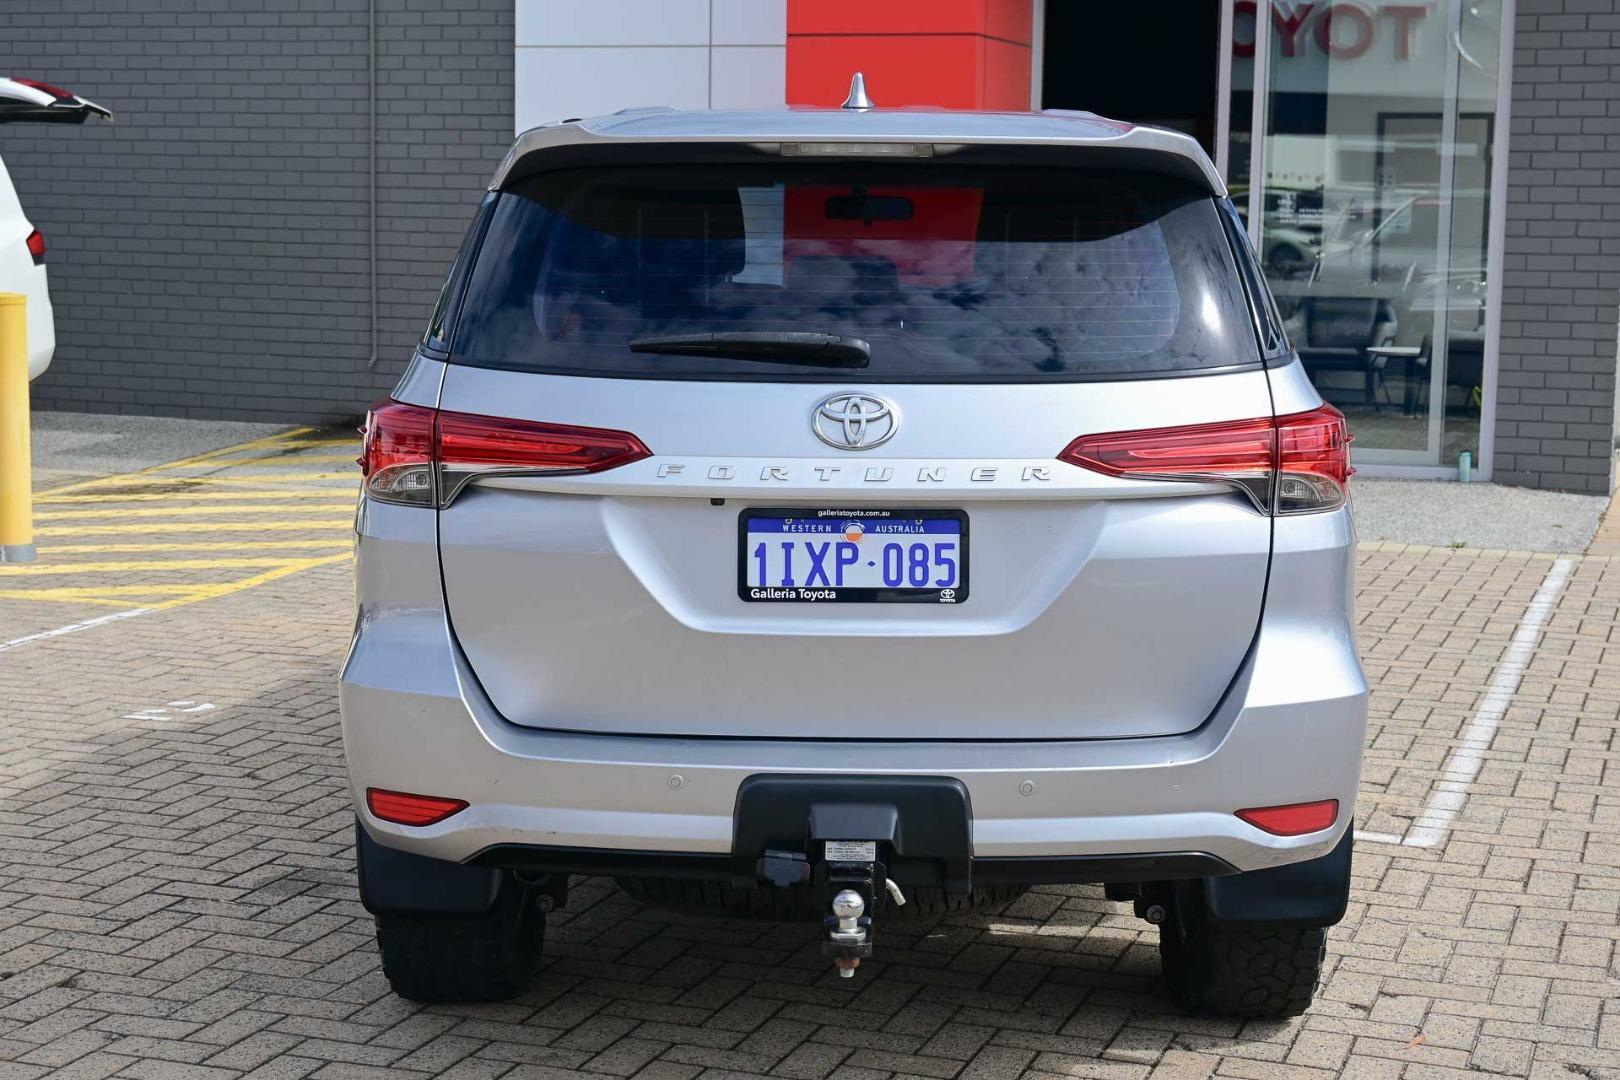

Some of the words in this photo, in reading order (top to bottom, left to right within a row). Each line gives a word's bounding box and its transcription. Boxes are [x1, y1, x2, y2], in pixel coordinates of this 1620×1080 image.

[656, 463, 1052, 483] FORTUNER
[817, 509, 891, 518] galleriatoyota.com.au
[782, 524, 832, 533] WESTERN
[875, 525, 925, 534] AUSTRALIA
[750, 588, 796, 599] Galleria
[798, 588, 837, 601] Toyota
